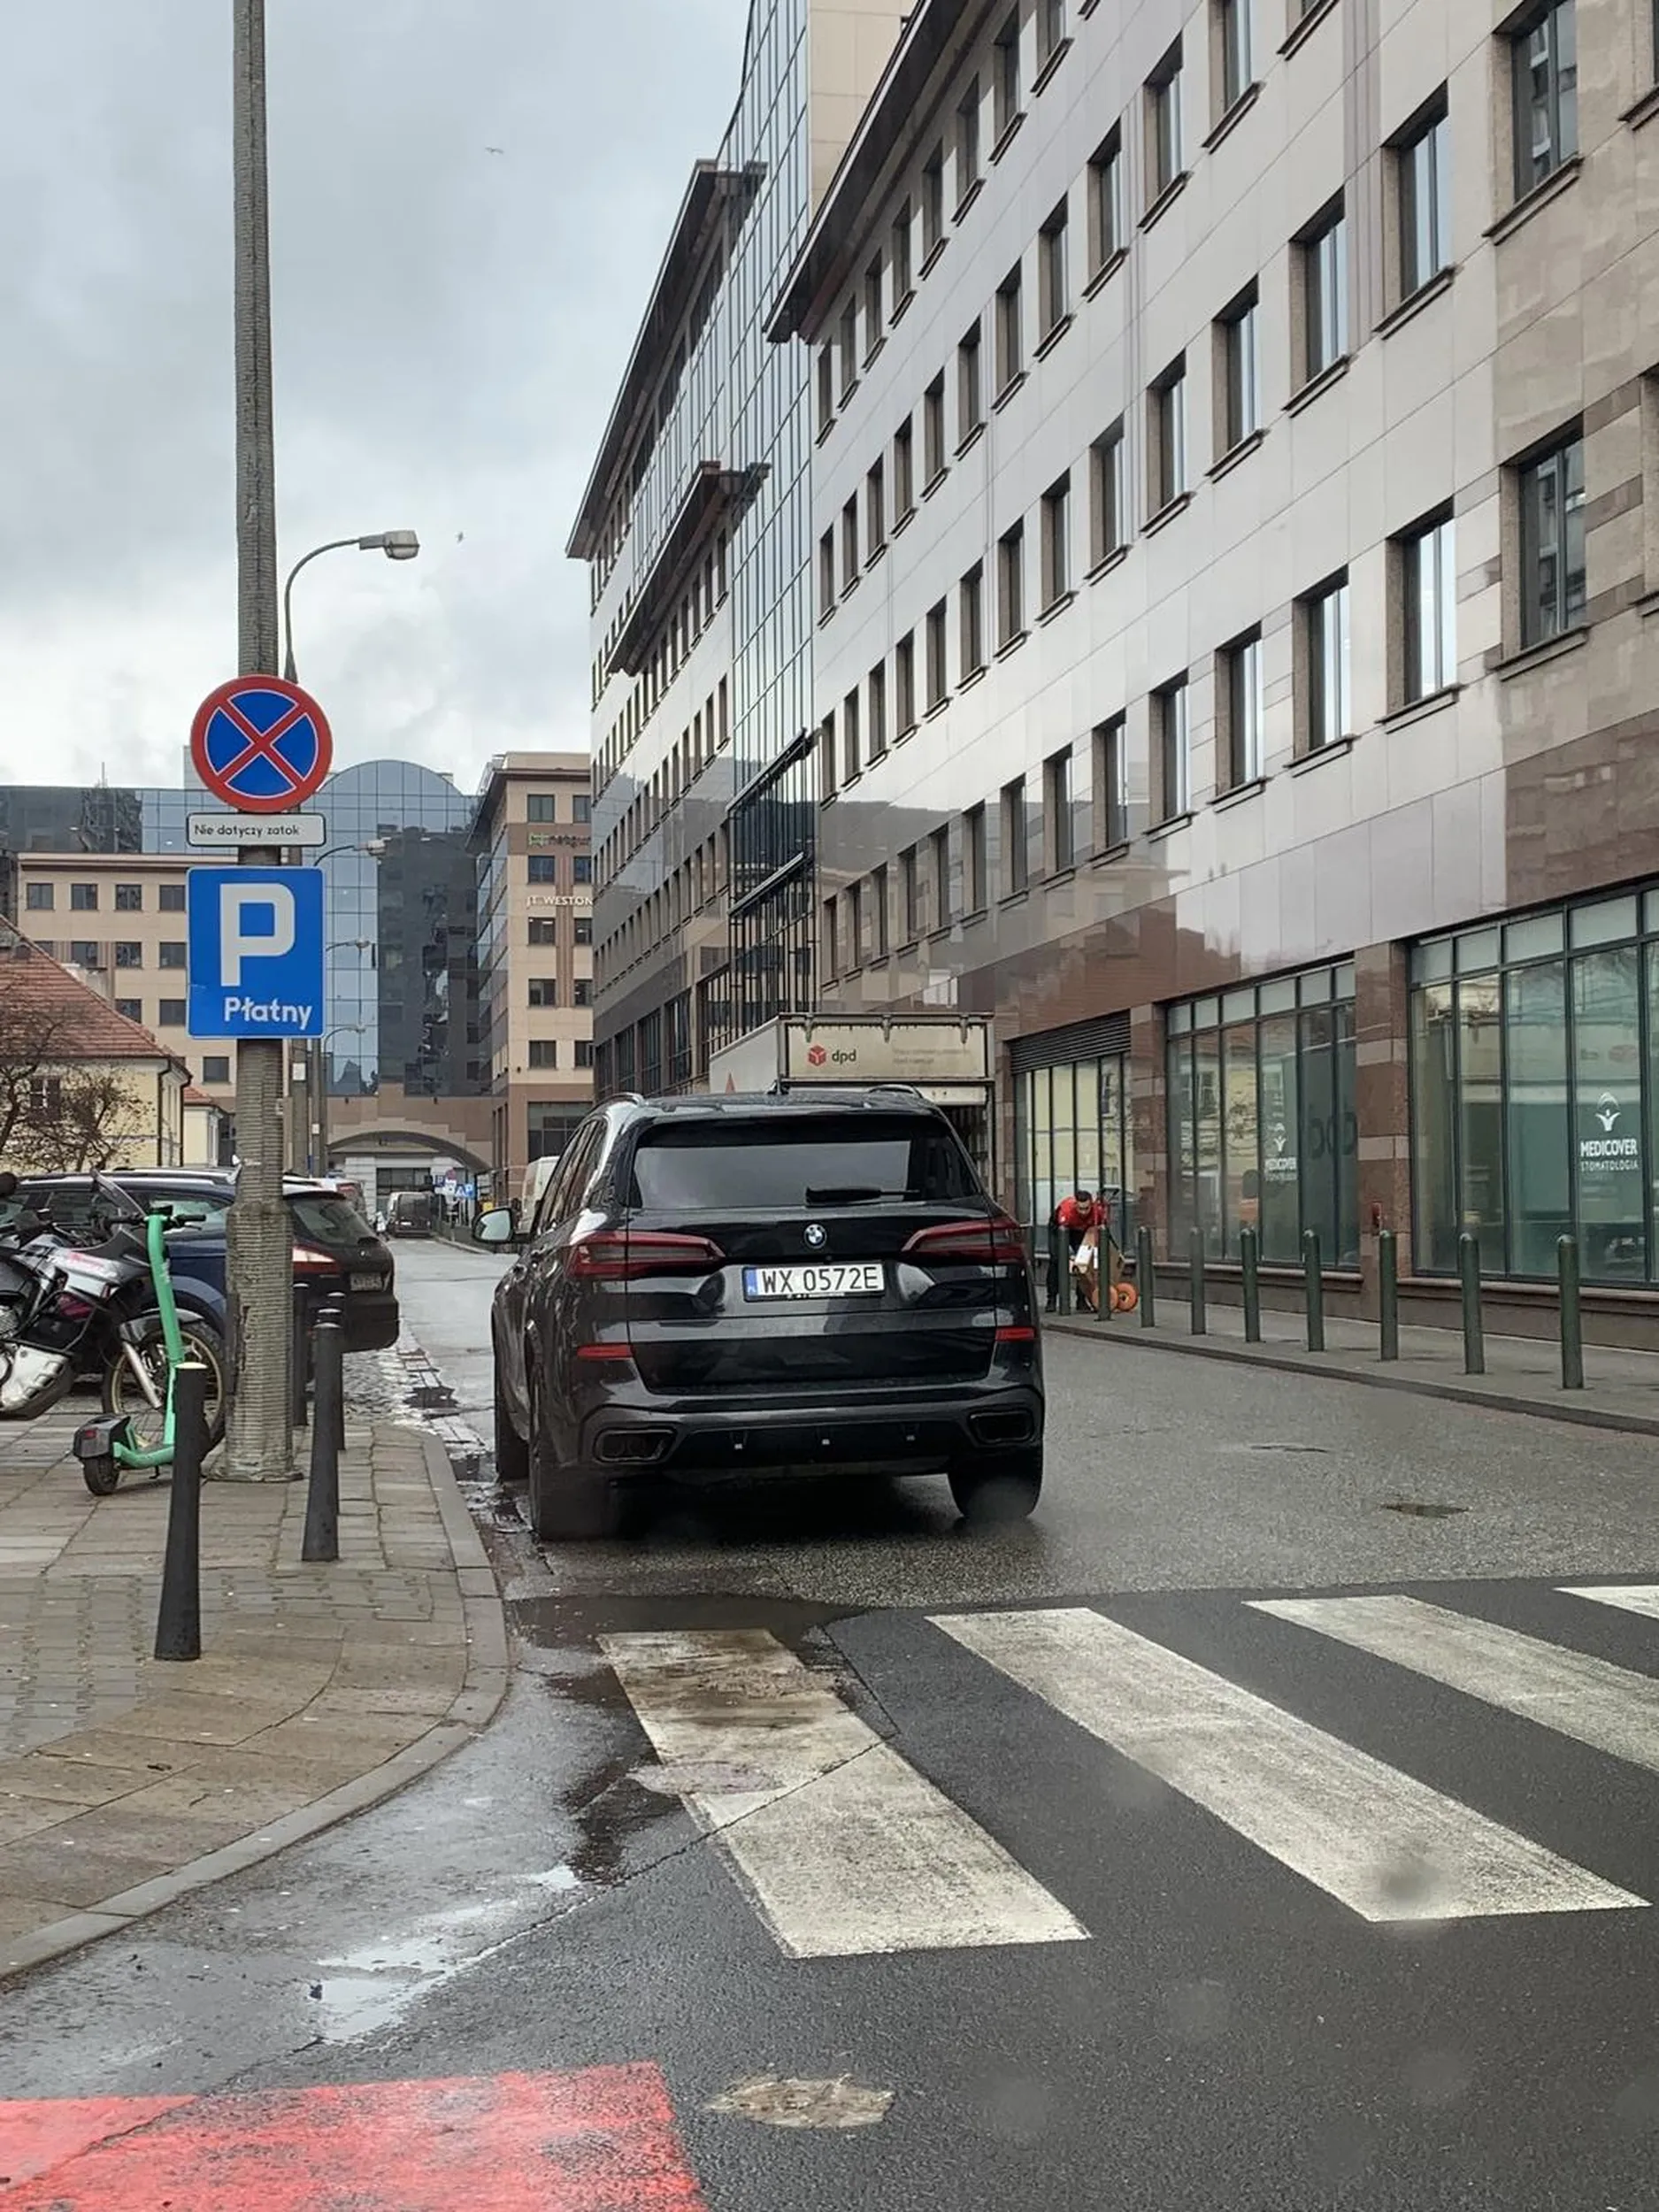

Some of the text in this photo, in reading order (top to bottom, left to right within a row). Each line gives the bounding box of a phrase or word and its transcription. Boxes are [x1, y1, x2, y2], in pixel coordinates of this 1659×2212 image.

[194, 824, 300, 838] Nie dotyczy zatok
[542, 895, 594, 906] WESTON
[220, 883, 296, 987] P
[224, 996, 312, 1031] Płatny
[831, 1048, 856, 1065] dpd
[1580, 1138, 1638, 1157] MEDICOVER
[1580, 1159, 1638, 1172] STOMATOLOGIA
[763, 1270, 793, 1294] WX
[803, 1266, 878, 1292] 0572E
